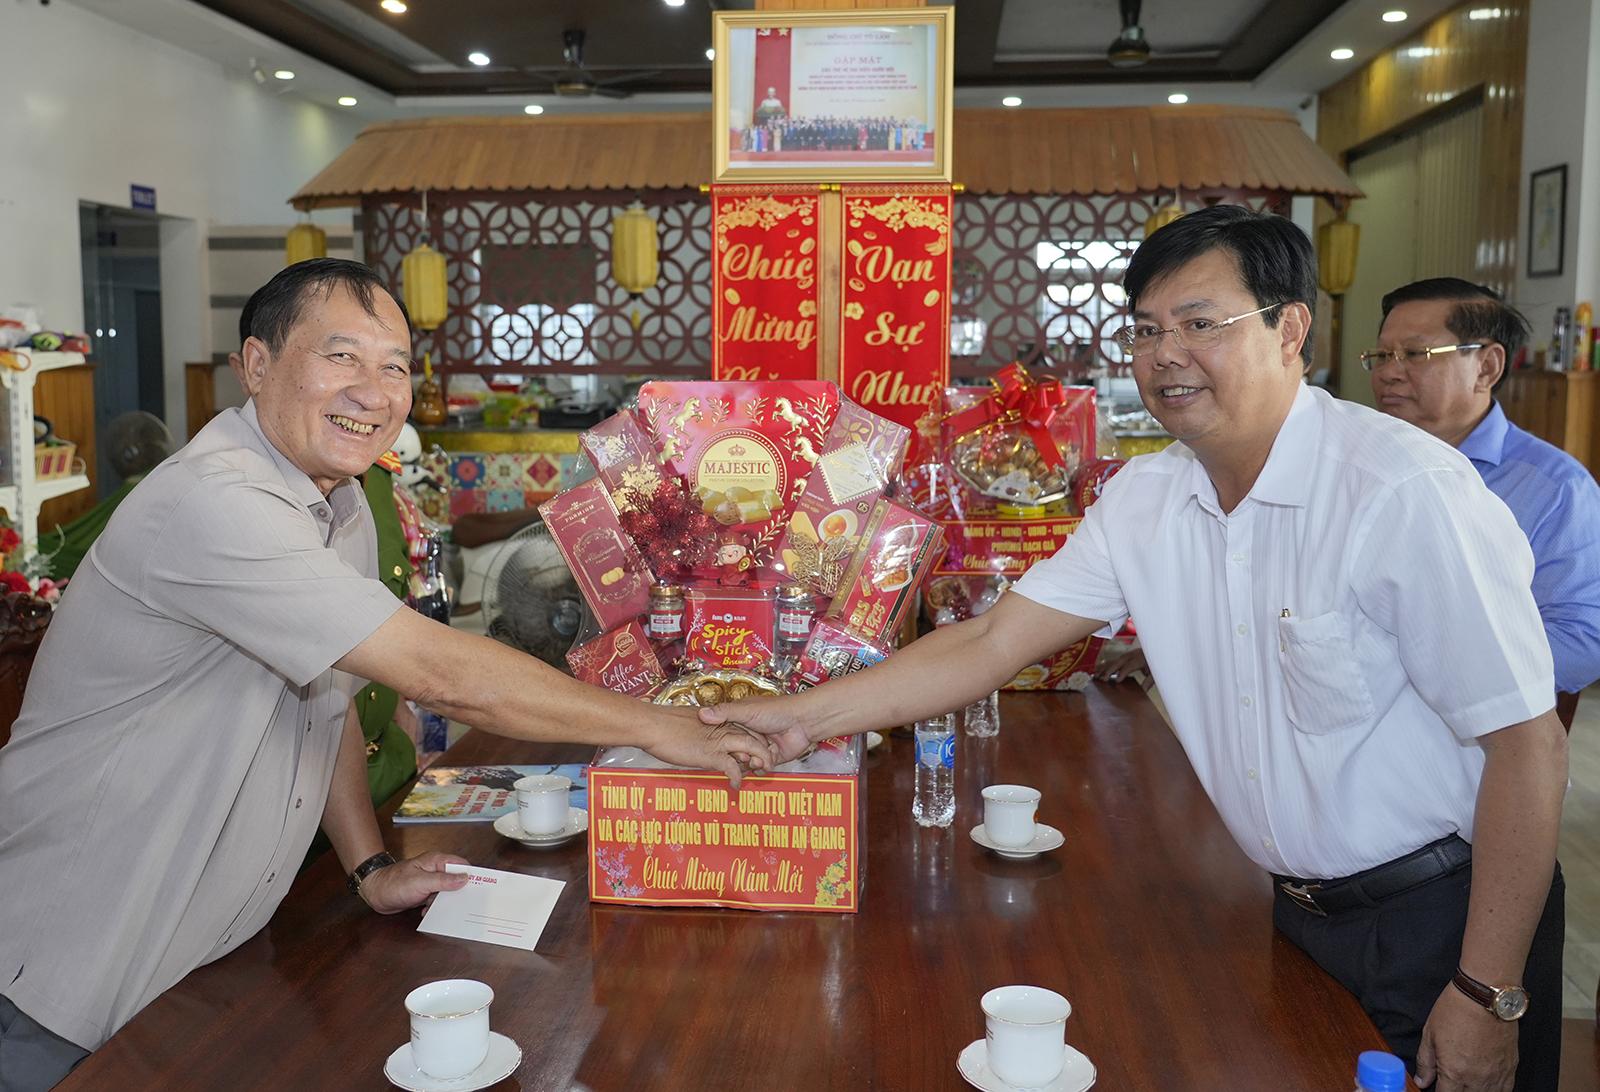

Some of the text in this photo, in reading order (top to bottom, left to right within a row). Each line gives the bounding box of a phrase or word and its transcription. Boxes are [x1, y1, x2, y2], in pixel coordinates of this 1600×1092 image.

[722, 243, 814, 281] Chúc
[855, 245, 936, 289] Vạn
[719, 306, 817, 350] Mừng
[864, 311, 926, 352] Sự
[704, 462, 770, 474] MAJESTIC
[702, 623, 754, 650] Spicy
[715, 641, 750, 656] stick
[602, 663, 635, 687] Coffee
[611, 670, 650, 693] STANT
[601, 780, 628, 810] TỈNH
[630, 781, 645, 811] ỦY
[655, 787, 686, 812] HĐND
[697, 788, 729, 813] UBND
[739, 789, 786, 818] UBMTTQ
[788, 788, 814, 818] VIỆT
[816, 792, 842, 817] NAM
[598, 815, 614, 842] VÀ
[616, 816, 638, 844] CÁC
[704, 821, 720, 846] VŨ
[723, 823, 760, 848] TRANG
[762, 820, 789, 849] TỈNH
[792, 825, 807, 849] AN
[810, 826, 846, 850] GIANG
[642, 855, 805, 898] Chúc Mừng Năm Mới
